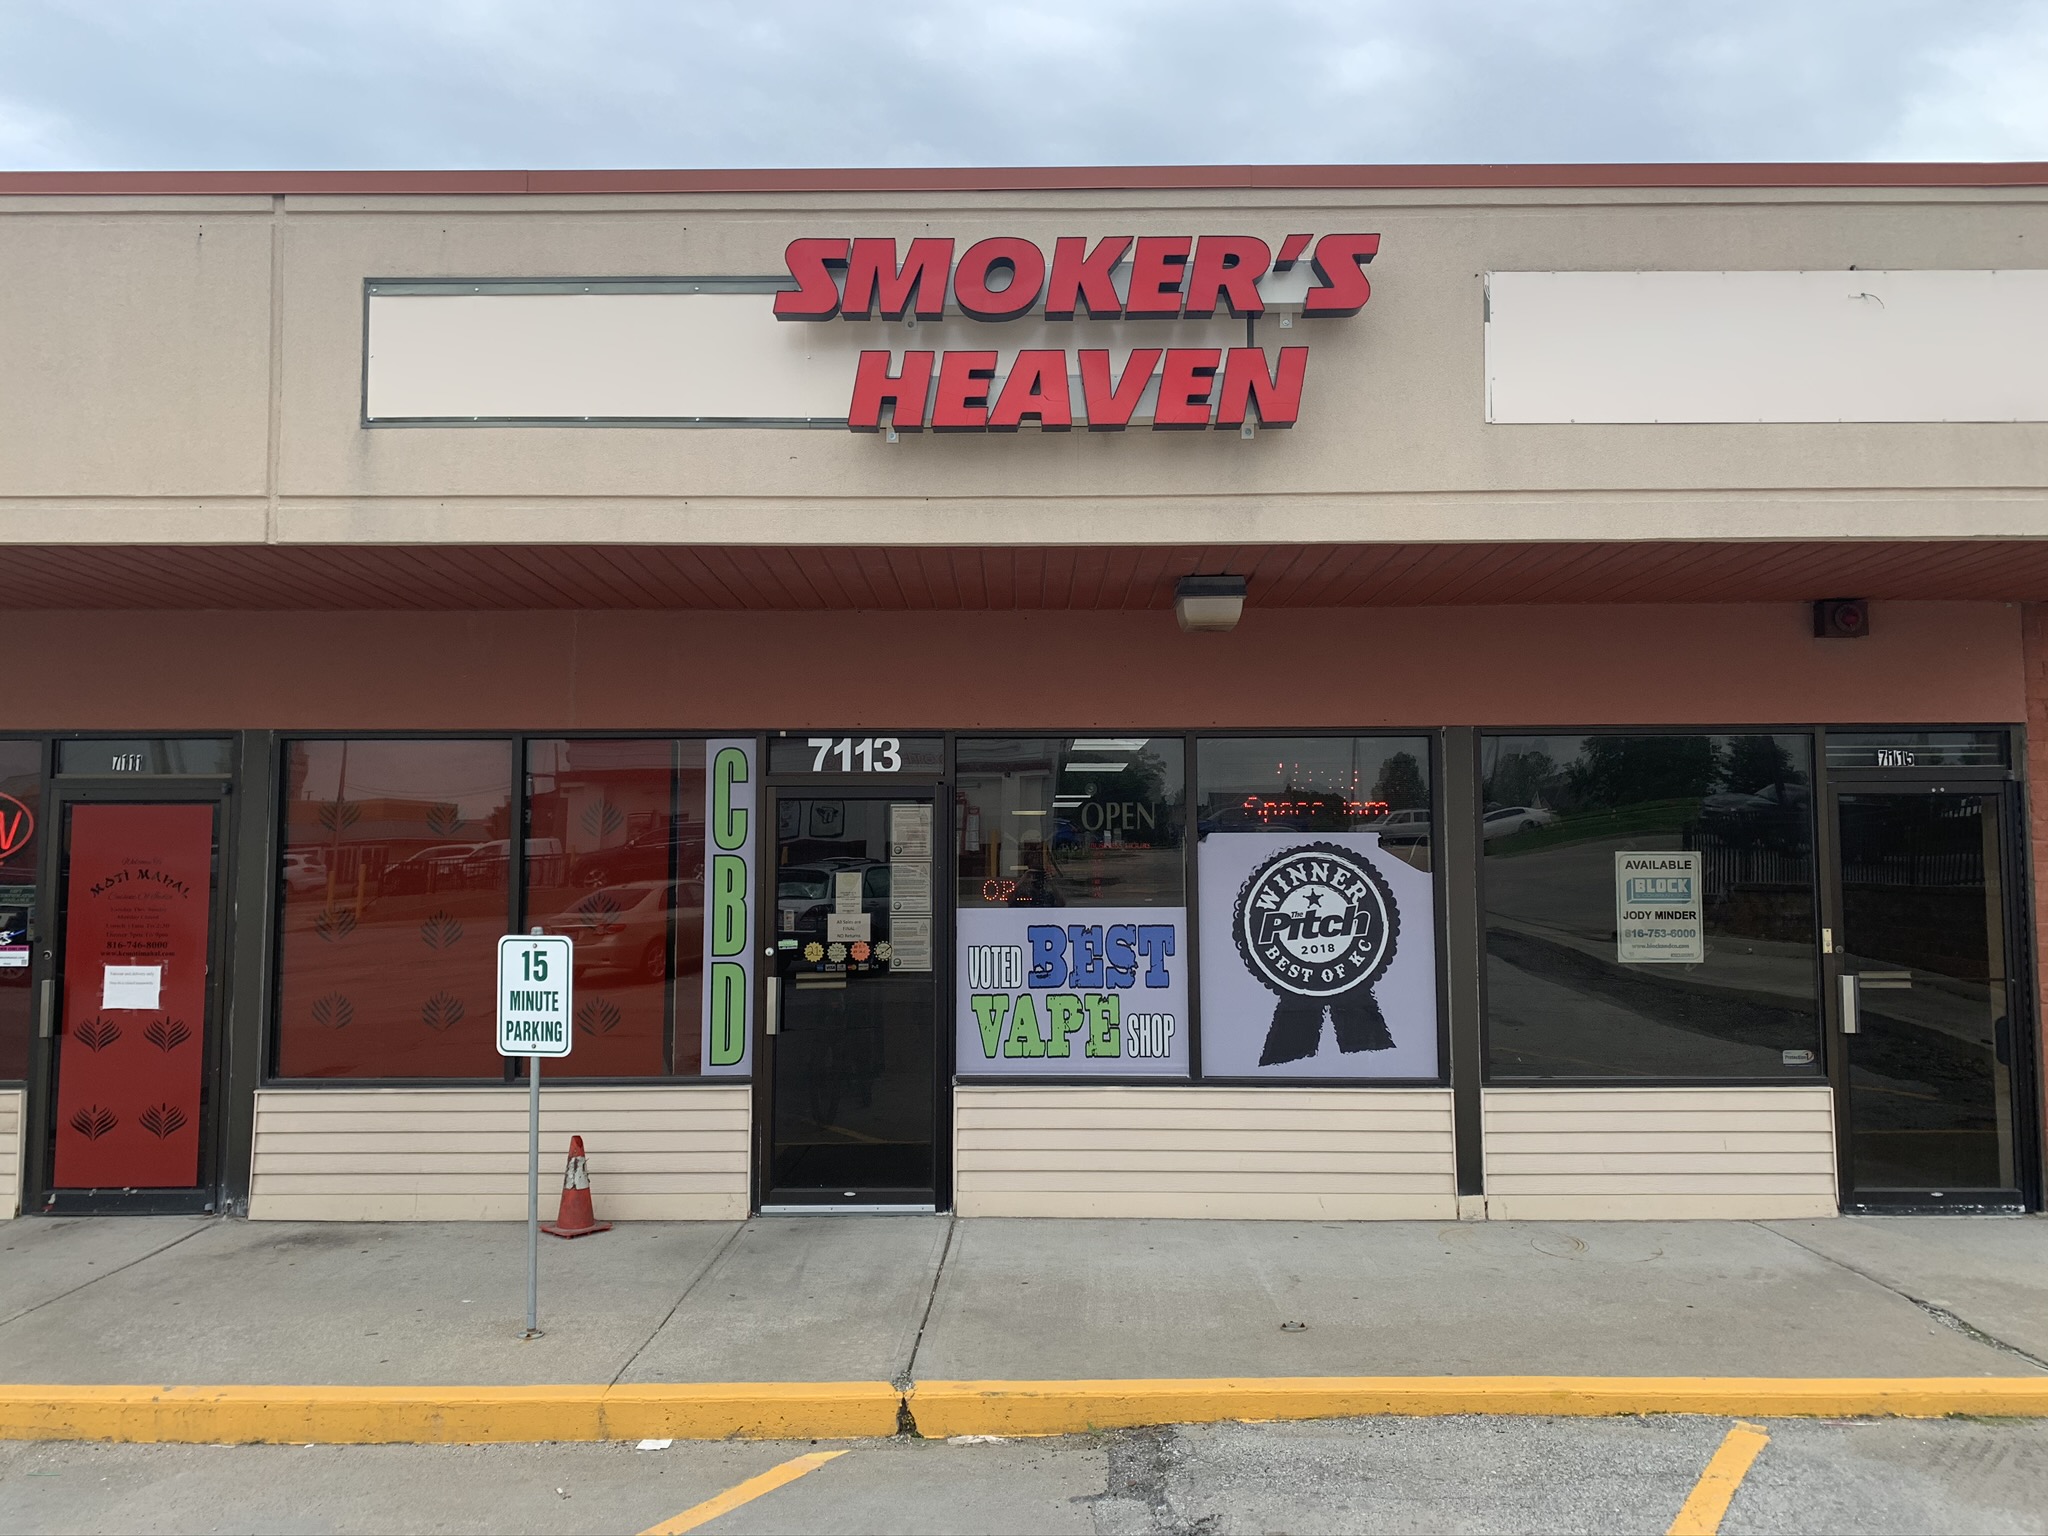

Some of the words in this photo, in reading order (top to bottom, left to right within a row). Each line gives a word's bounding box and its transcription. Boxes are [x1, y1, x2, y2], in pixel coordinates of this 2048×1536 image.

[773, 233, 1381, 322] SMOKER'S
[847, 346, 1310, 434] HEAVEN
[807, 737, 902, 773] 7113
[1081, 801, 1156, 831] OPEN
[1624, 860, 1692, 870] AVAILABLE
[1255, 861, 1367, 911] WINNER
[1634, 878, 1689, 893] BLOCK
[1258, 903, 1371, 945] Pitch
[1623, 910, 1653, 920] JODY
[1654, 910, 1697, 920] MINDER
[1301, 943, 1335, 955] 2018
[1624, 928, 1697, 938] 816-753-6000
[521, 950, 548, 982] 15
[967, 945, 1022, 989] VOTED
[1027, 924, 1176, 989] BEST
[1265, 945, 1314, 982] BEST
[1320, 963, 1346, 983] OF
[1348, 939, 1372, 968] KC
[509, 990, 559, 1012] MINUTE
[505, 1020, 563, 1042] PARKING
[971, 993, 1121, 1058] VAPE
[1126, 1013, 1176, 1058] SHOP
